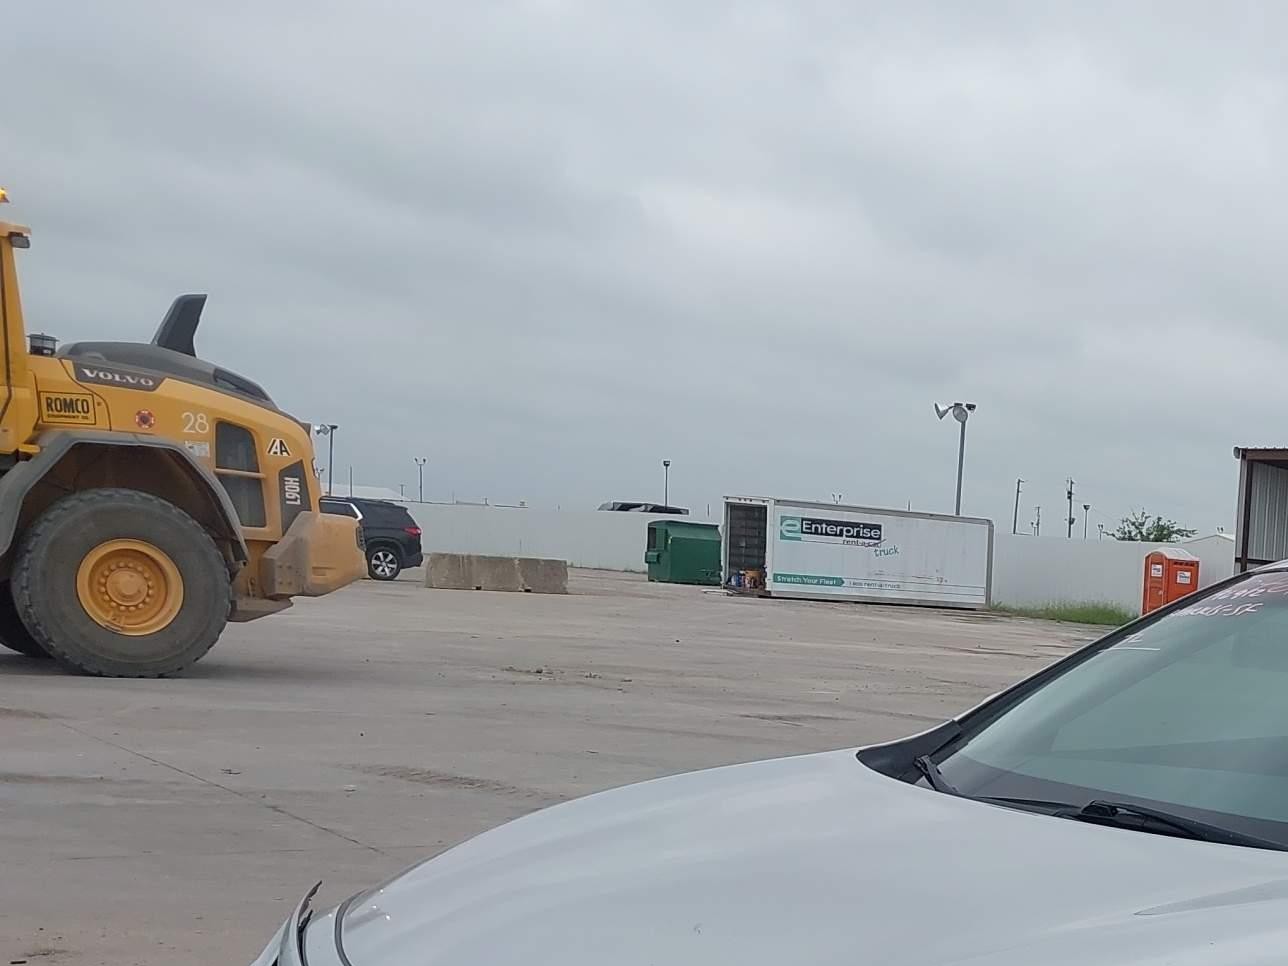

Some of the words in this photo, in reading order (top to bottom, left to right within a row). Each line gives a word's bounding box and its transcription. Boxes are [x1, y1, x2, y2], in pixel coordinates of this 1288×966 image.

[82, 368, 155, 386] VOLVO
[46, 396, 90, 414] ROMCO
[181, 411, 209, 433] 28
[284, 477, 301, 505] L90H
[802, 520, 881, 539] Enterprise
[874, 545, 899, 557] truck
